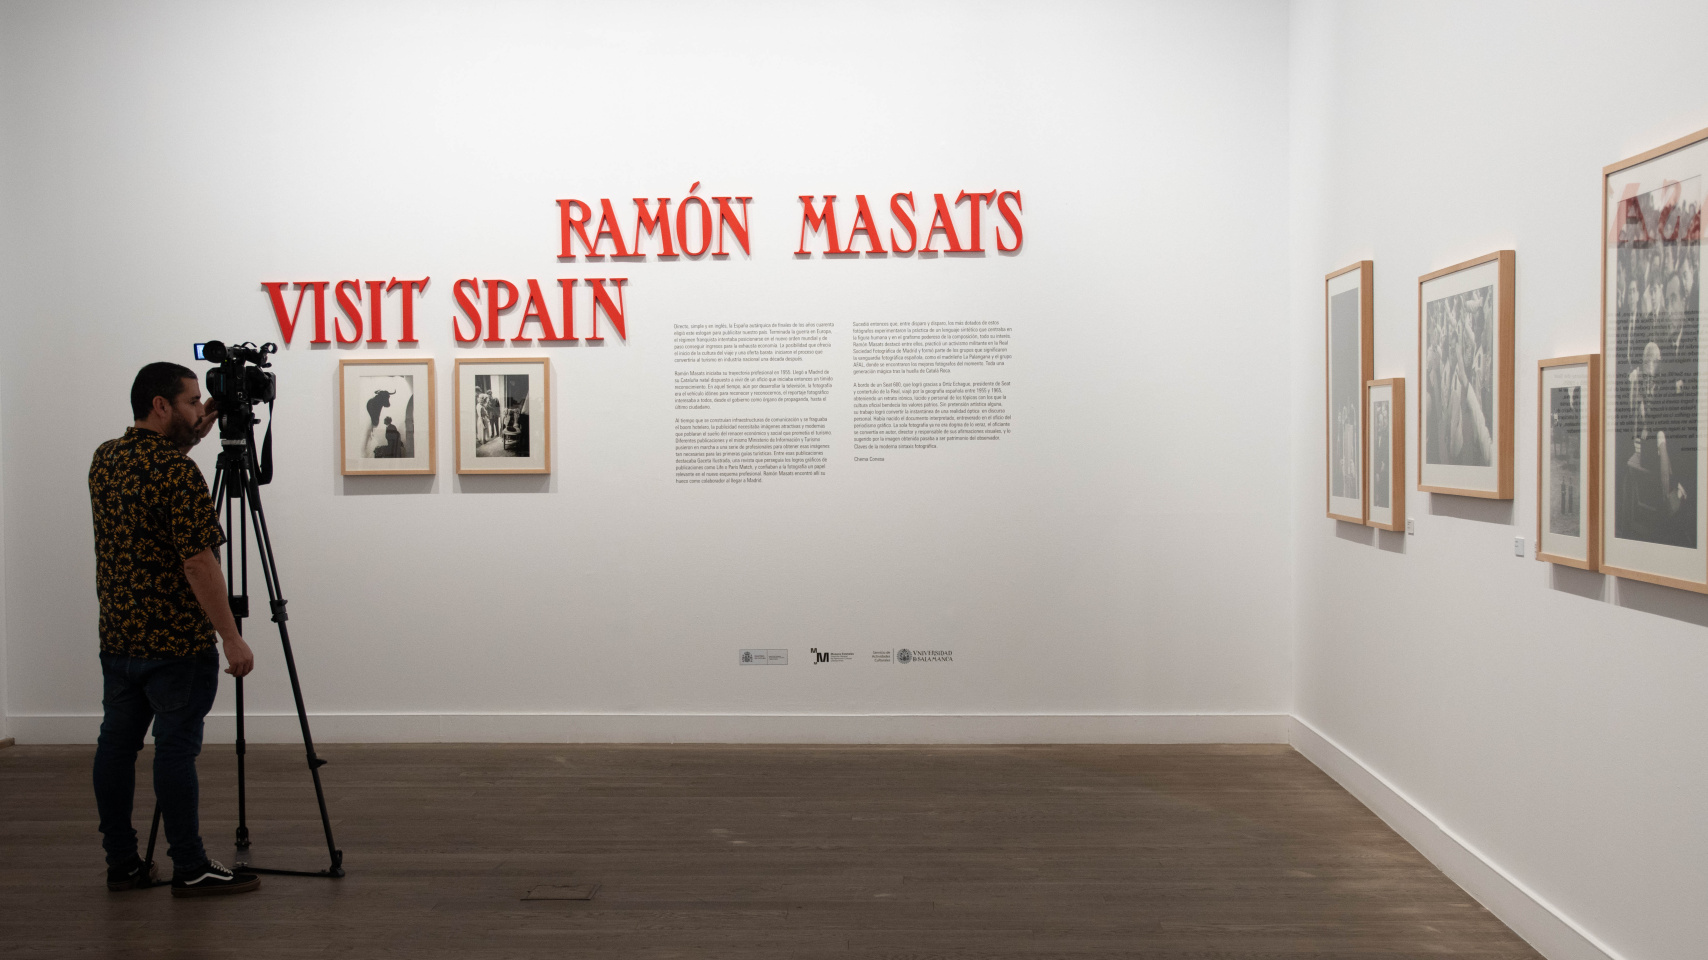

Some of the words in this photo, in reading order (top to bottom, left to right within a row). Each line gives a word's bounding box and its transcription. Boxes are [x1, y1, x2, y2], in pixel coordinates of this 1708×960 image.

[556, 181, 753, 258] RAMÓN
[793, 189, 1024, 254] MASATS
[260, 276, 431, 344] VISIT
[452, 277, 628, 343] SPAIN
[816, 653, 829, 662] M
